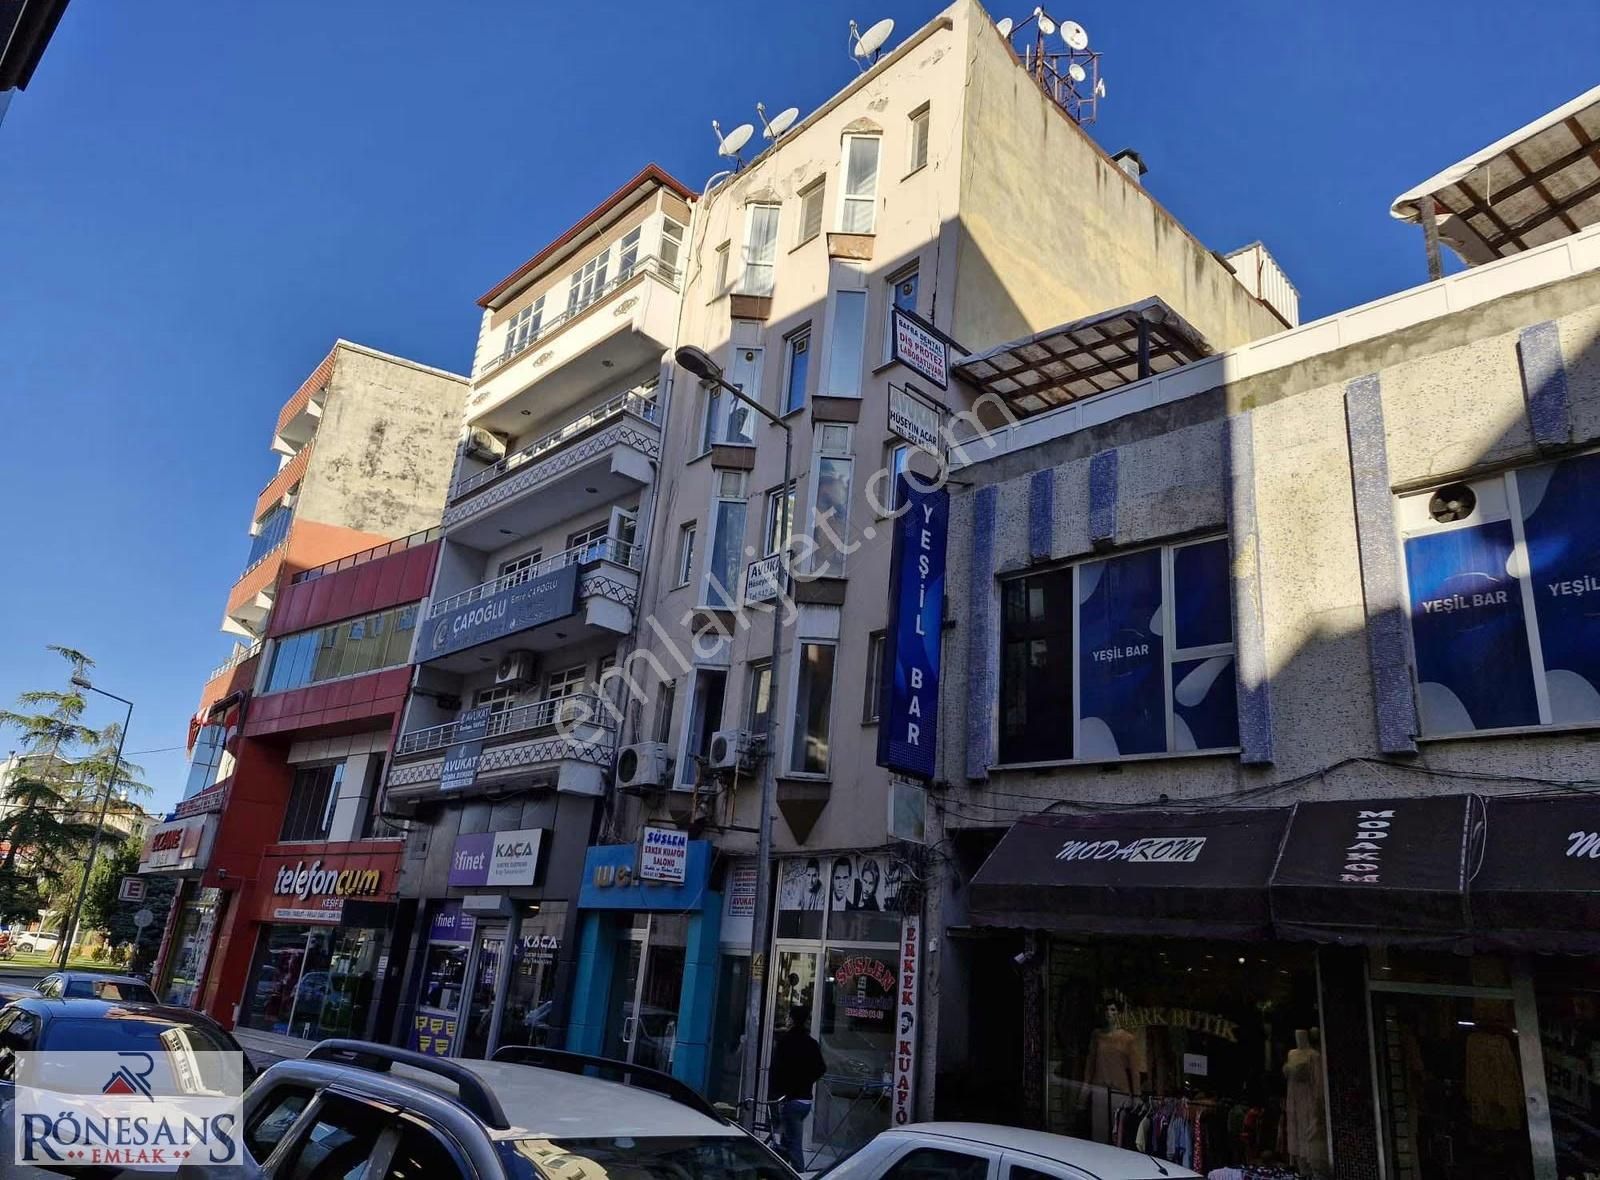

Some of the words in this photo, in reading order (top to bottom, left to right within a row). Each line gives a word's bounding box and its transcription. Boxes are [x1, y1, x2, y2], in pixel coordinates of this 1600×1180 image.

[915, 342, 943, 368] PROTEZ
[920, 428, 937, 446] ACAR
[915, 503, 933, 636] YEŞİL
[1422, 594, 1469, 613] YEŞİL
[1471, 590, 1509, 607] BAR
[1548, 575, 1600, 597] YEŞİL
[453, 598, 507, 638] ÇAPOĞLU
[1092, 646, 1124, 662] YEŞİL
[1125, 644, 1149, 657] BAR
[908, 666, 923, 746] BAR
[443, 756, 478, 773] AVUKAT
[495, 841, 533, 859] KAÇA
[1339, 810, 1396, 882] MODAKOM
[127, 882, 141, 896] E
[273, 860, 381, 901] telefoncum
[835, 956, 896, 993] SÜSLEN
[902, 928, 915, 1006] ERKEK
[895, 1040, 911, 1125] KUAFÖ
